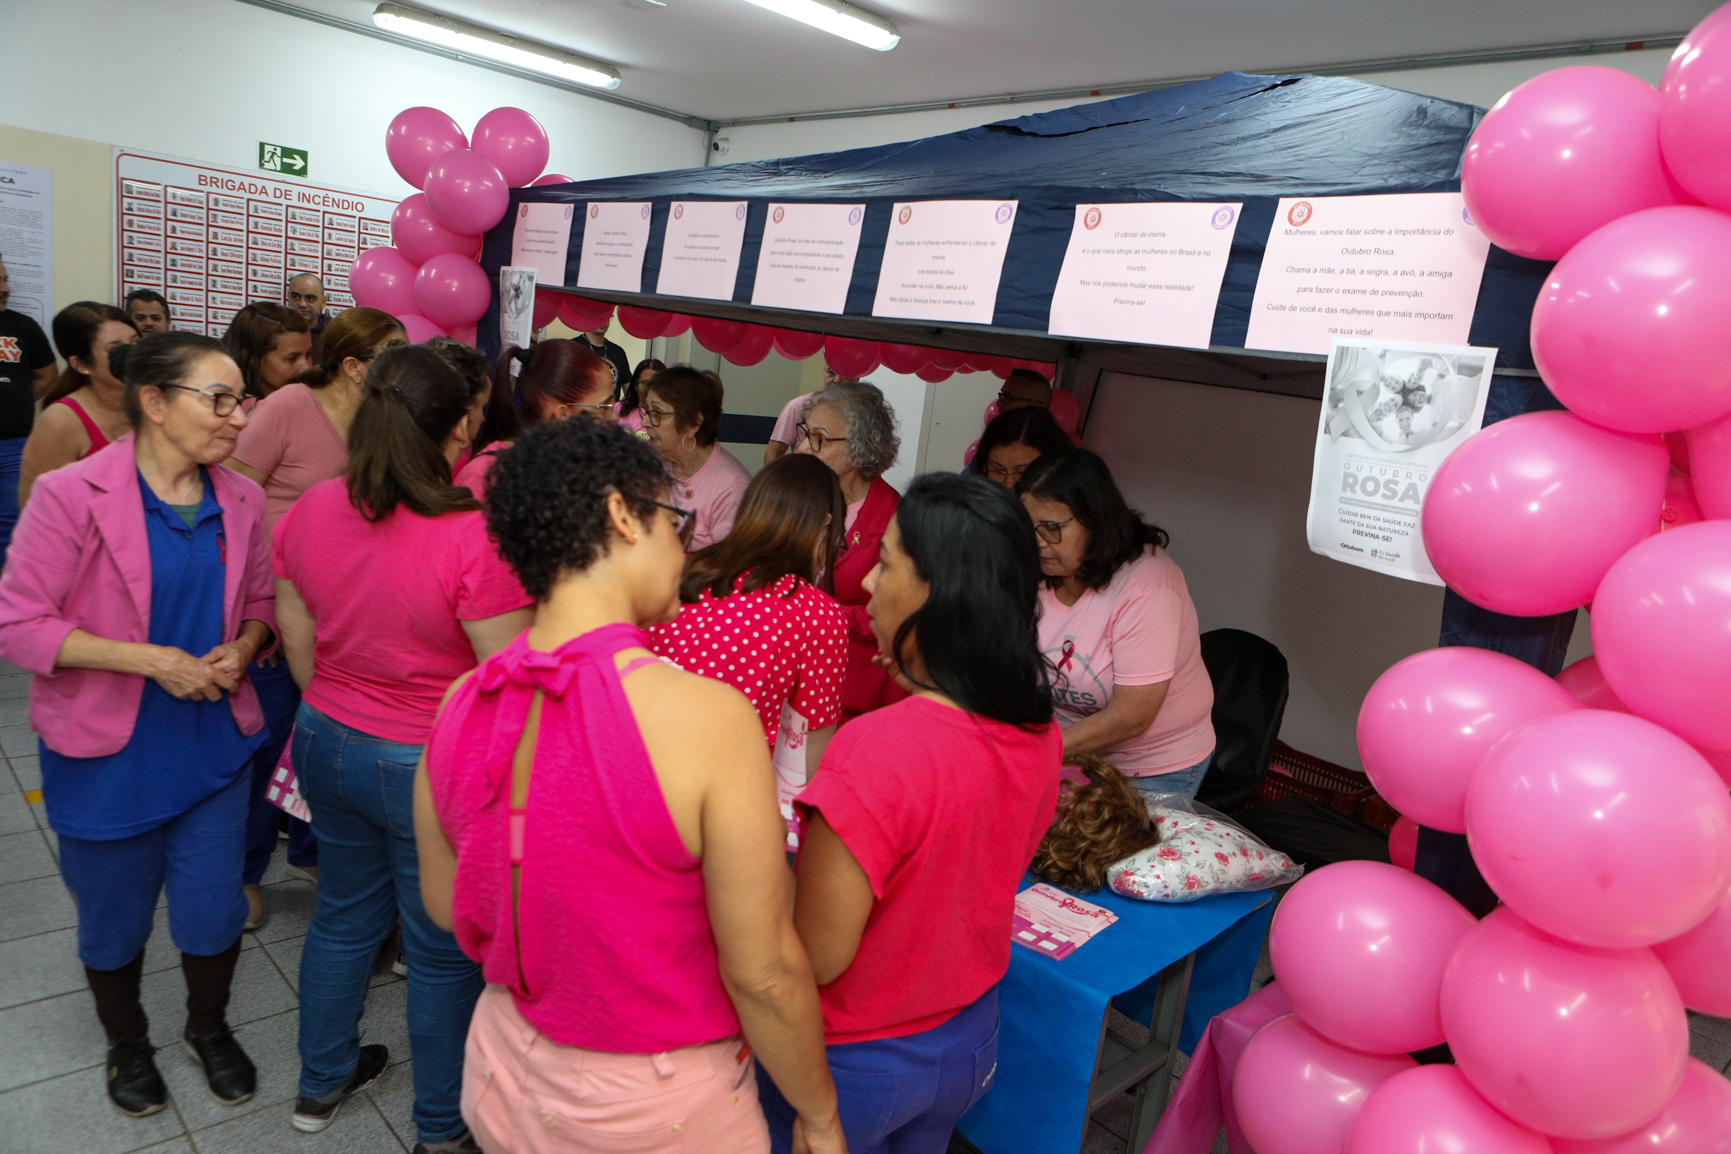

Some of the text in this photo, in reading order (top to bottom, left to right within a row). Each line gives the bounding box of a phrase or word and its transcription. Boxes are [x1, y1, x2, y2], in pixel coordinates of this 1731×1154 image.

[198, 174, 269, 197] BRIGADA
[273, 187, 293, 201] DE
[297, 191, 365, 213] INCÊNDIO
[1395, 228, 1441, 237] importância
[1341, 247, 1371, 255] Outubro
[1319, 267, 1337, 275] mãe,
[1367, 269, 1390, 277] sogra,
[1400, 269, 1416, 277] avó,
[1427, 270, 1452, 279] amiga
[1092, 280, 1101, 288] nós
[1370, 288, 1379, 296] de
[1381, 290, 1424, 298] prevenção.
[1114, 298, 1145, 306] Previna-se!
[1267, 303, 1286, 311] Cuide
[1288, 304, 1297, 312] de
[1340, 308, 1374, 316] mulheres
[1377, 310, 1391, 318] que
[1393, 310, 1412, 318] mais
[1415, 311, 1453, 320] importam
[1355, 328, 1373, 336] vida!
[1375, 457, 1404, 465] CAMPANHA
[1405, 461, 1429, 469] INTERNA
[1344, 462, 1427, 482] OUTUBRO
[1341, 471, 1421, 505] ROSA
[1338, 508, 1358, 517] CUIDAR
[1382, 517, 1402, 526] SAÚDE
[1340, 518, 1355, 526] PARTE
[1378, 526, 1410, 537] NATUREZA.
[1352, 529, 1392, 542] PREVINA-SE!
[1341, 542, 1364, 553] Ortobom
